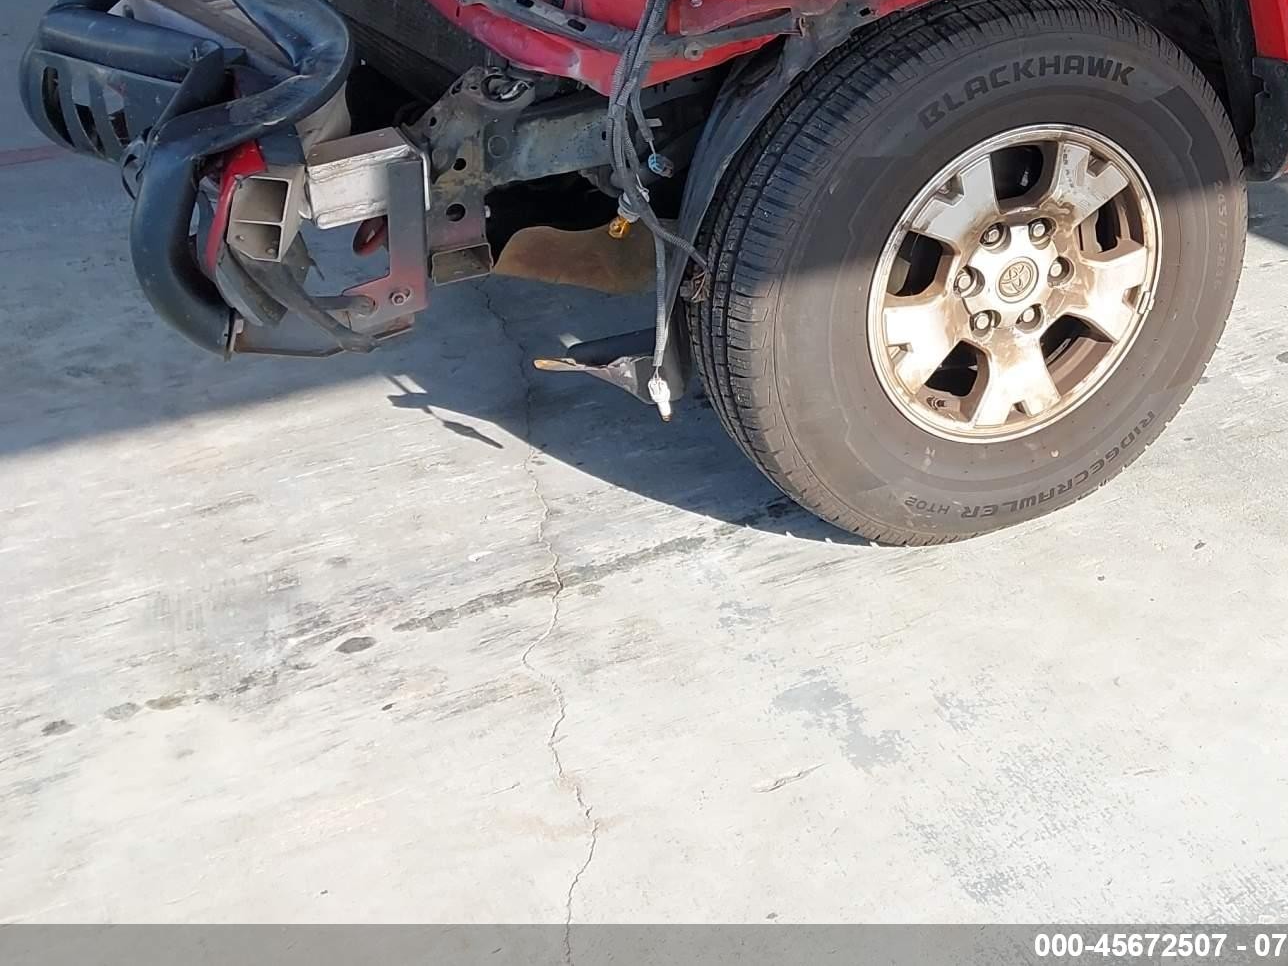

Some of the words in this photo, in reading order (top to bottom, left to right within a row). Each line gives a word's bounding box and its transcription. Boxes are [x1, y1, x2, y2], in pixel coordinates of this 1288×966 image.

[917, 54, 1135, 131] BLACKHAWK
[960, 410, 1156, 519] RIDGECRAWLER
[903, 496, 951, 515] HT02
